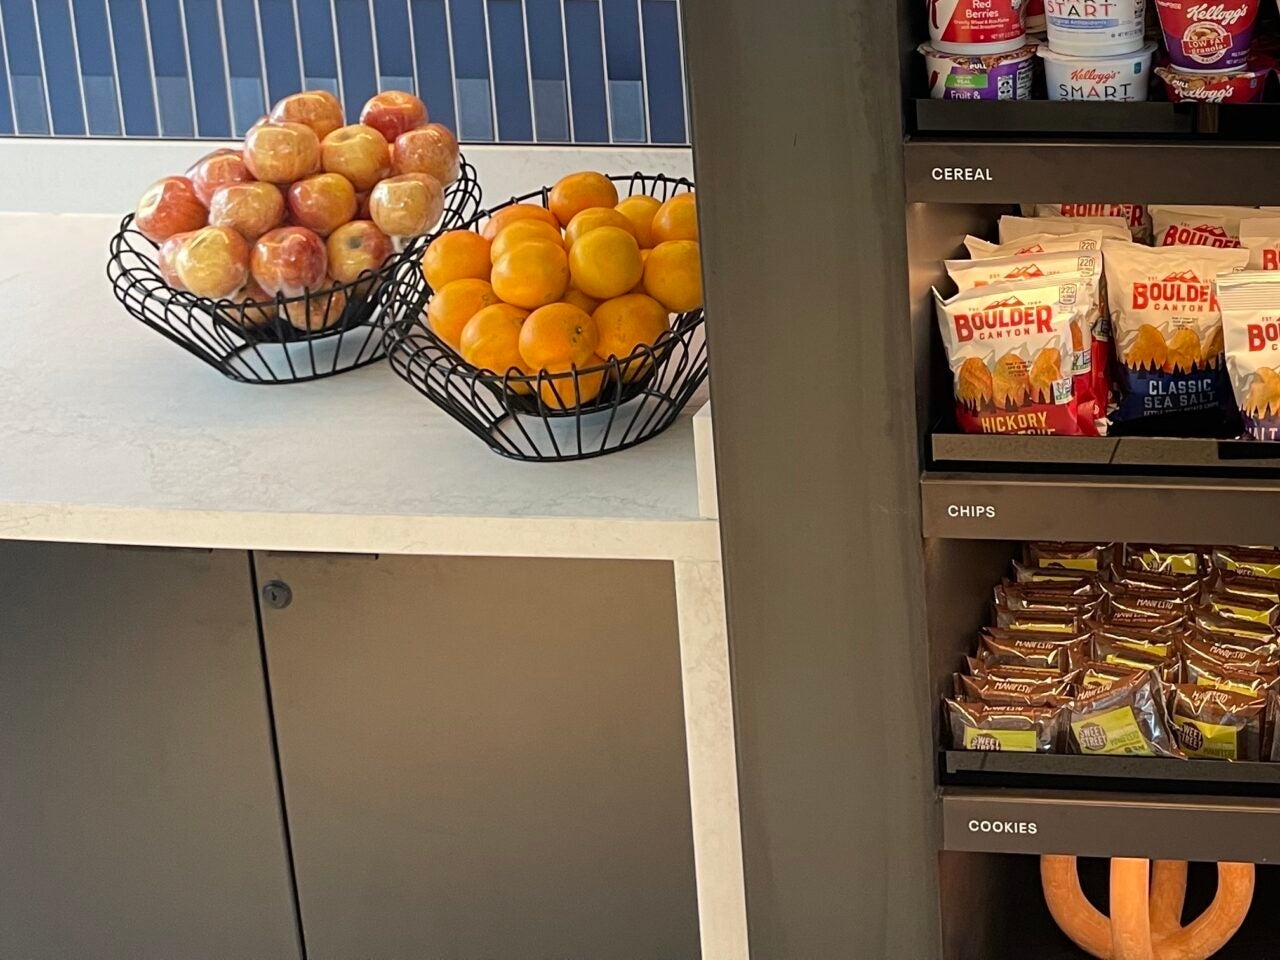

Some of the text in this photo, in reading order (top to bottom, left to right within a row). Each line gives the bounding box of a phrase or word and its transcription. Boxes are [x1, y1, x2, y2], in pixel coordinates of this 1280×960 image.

[965, 8, 999, 19] Berries
[1047, 1, 1113, 17] START
[1059, 83, 1132, 98] SMART
[931, 167, 993, 182] CEREAL
[953, 305, 1054, 343] BOULDER
[1149, 378, 1212, 396] CLASSIC
[1144, 391, 1215, 409] SEA SALT
[981, 411, 1048, 433] HICKORY
[947, 504, 996, 518] CHIPS
[1079, 724, 1104, 738] SWEET
[1079, 734, 1107, 748] STREET
[968, 819, 1038, 835] COOKIES
